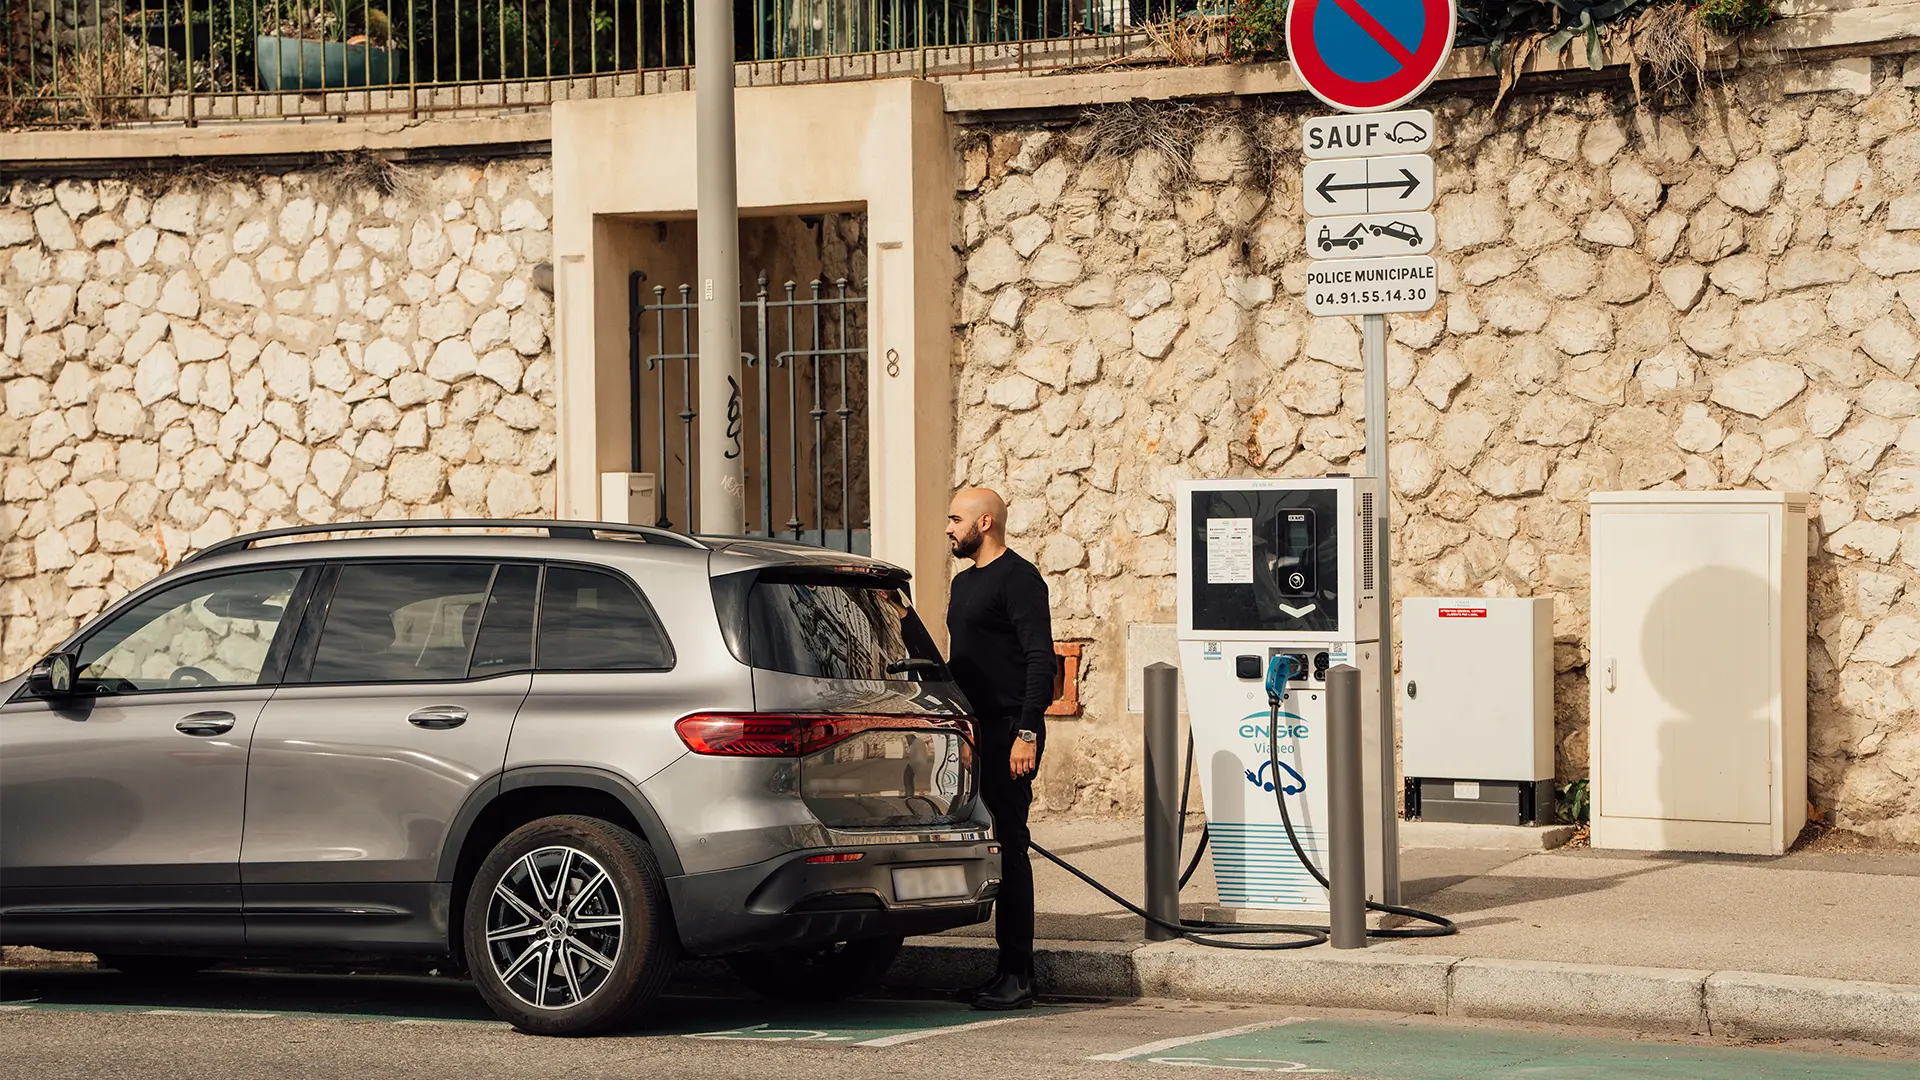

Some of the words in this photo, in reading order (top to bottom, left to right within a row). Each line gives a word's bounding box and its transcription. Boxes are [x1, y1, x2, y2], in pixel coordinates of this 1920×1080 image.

[1309, 123, 1379, 150] SAUF
[1307, 271, 1352, 285] POLICE
[1354, 266, 1434, 283] MUNICIPALE
[1315, 288, 1427, 305] 04.91.55.14.30
[886, 348, 900, 378] 8
